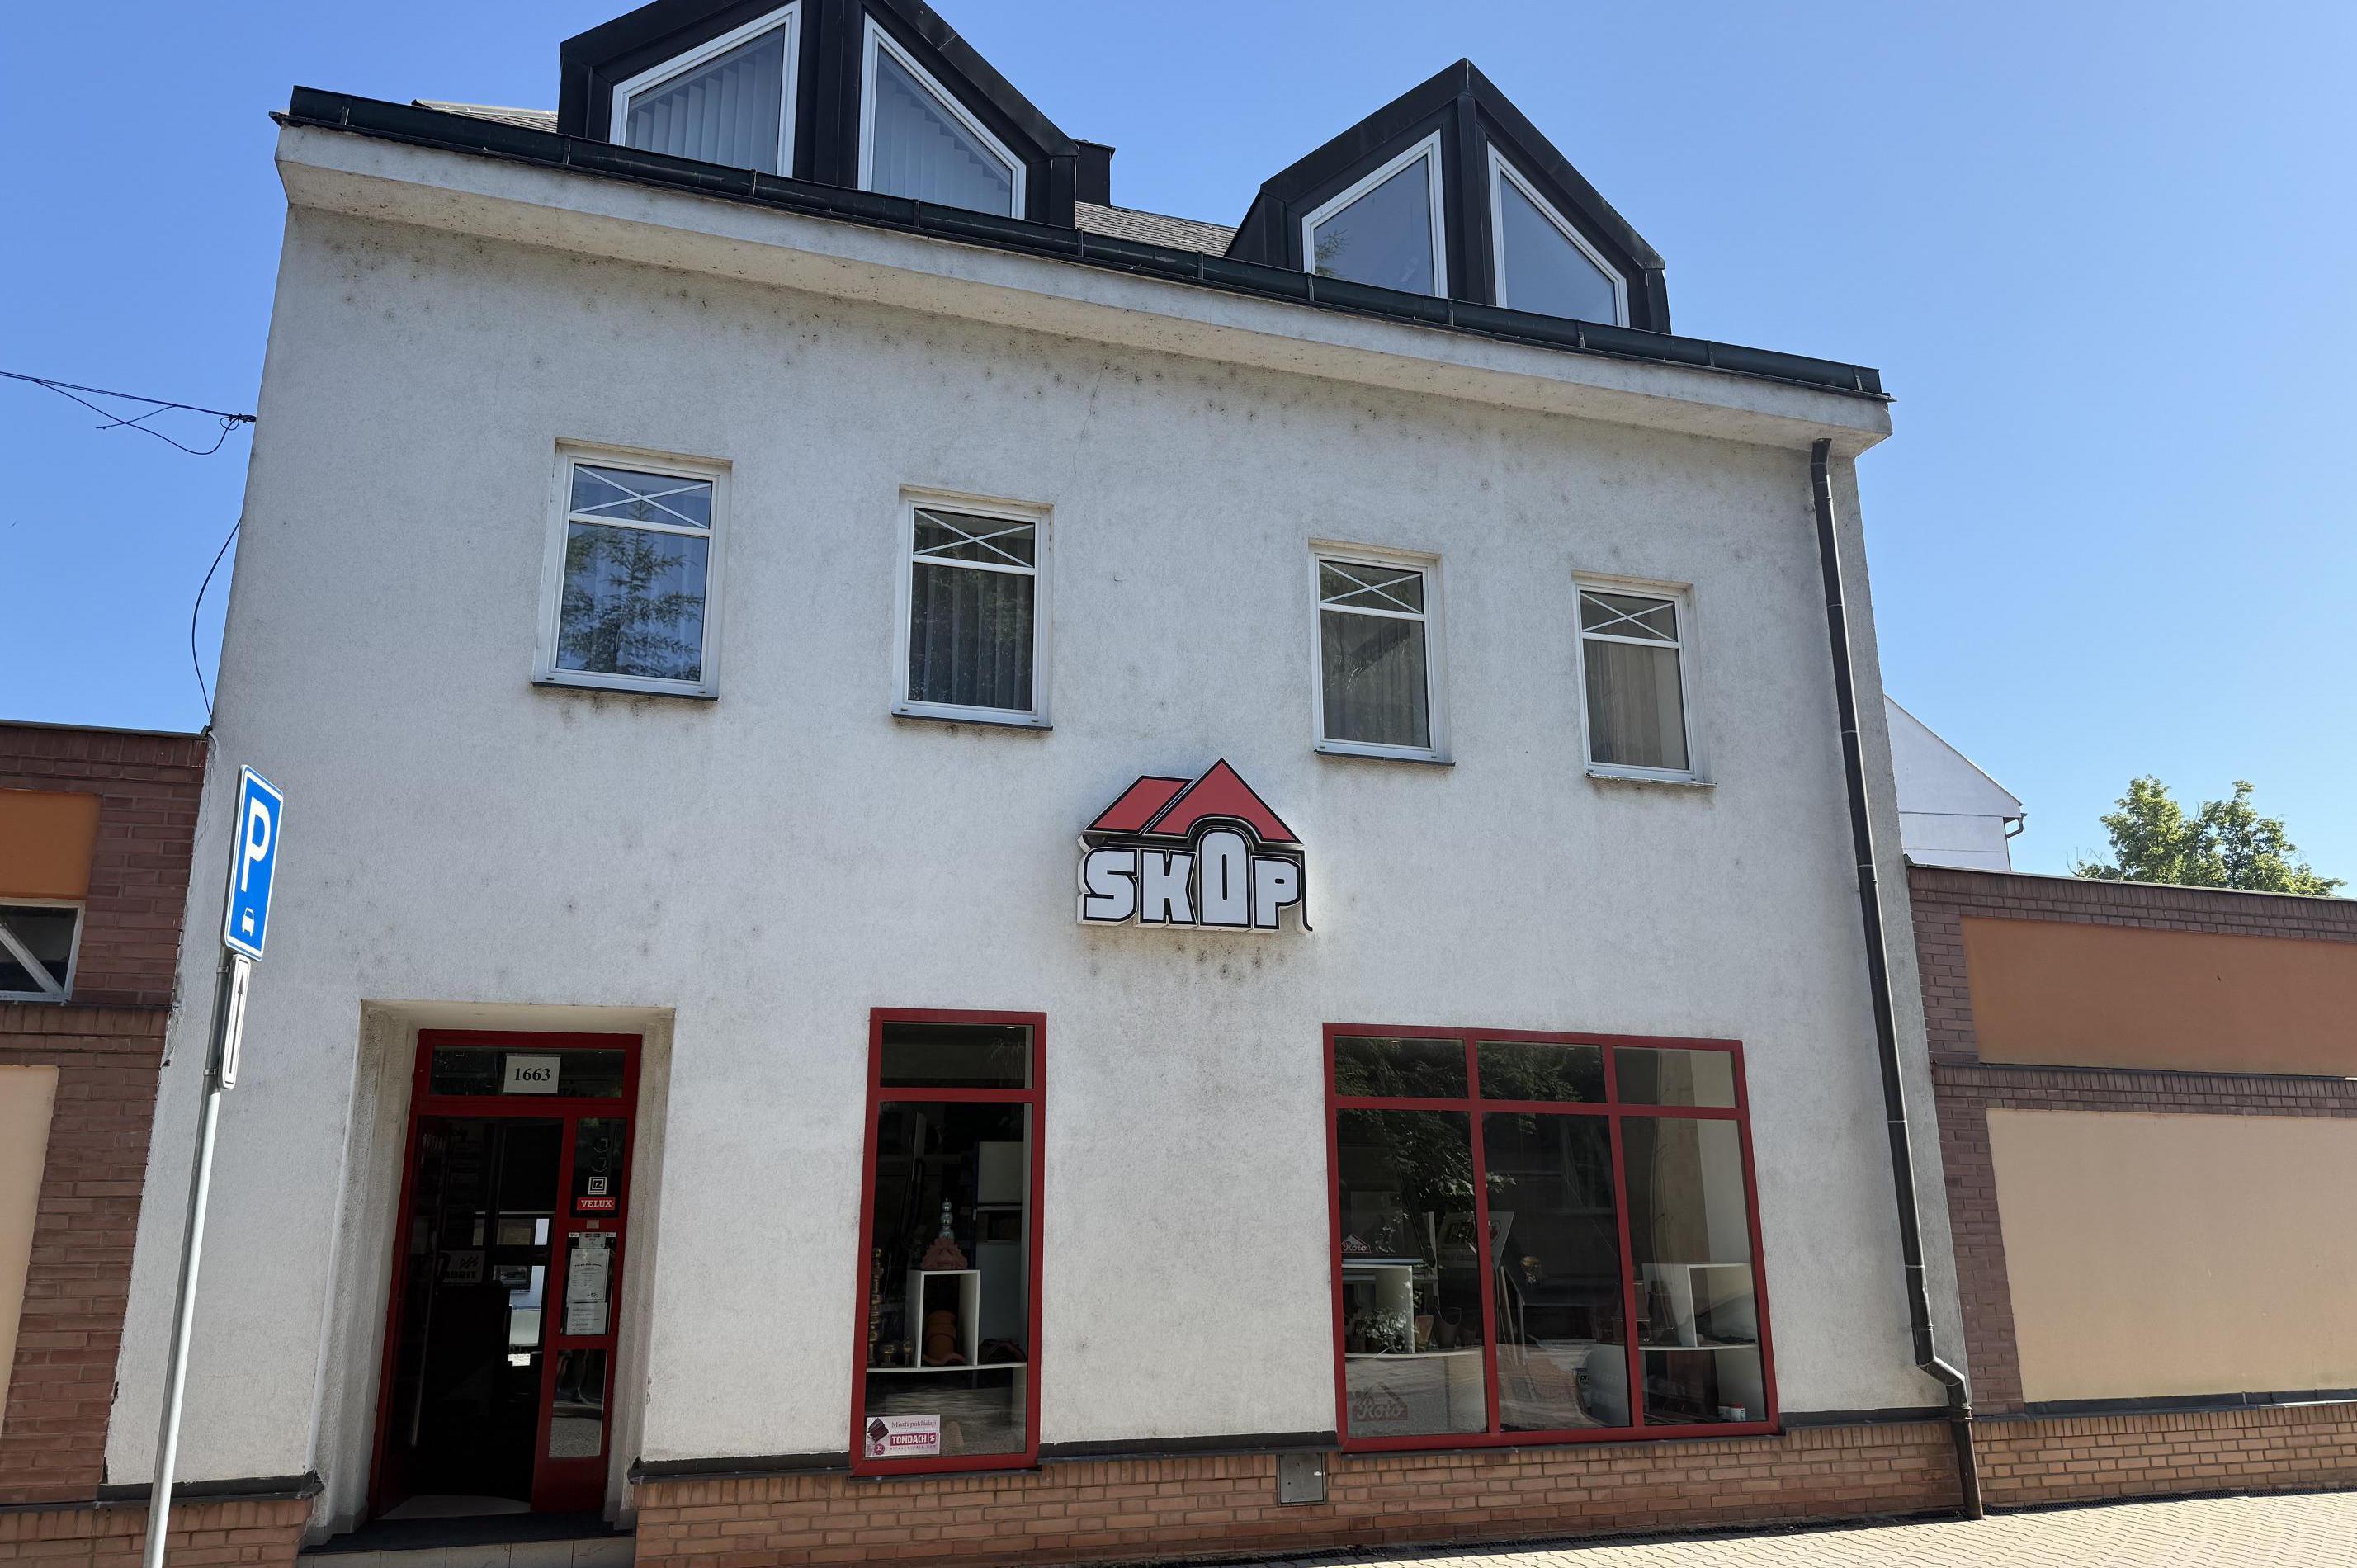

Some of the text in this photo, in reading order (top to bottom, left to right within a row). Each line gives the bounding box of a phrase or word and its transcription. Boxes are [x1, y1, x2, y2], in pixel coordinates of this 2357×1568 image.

[241, 796, 271, 893] P
[1082, 828, 1301, 930] SKOP
[513, 1067, 551, 1082] 1663
[581, 1199, 612, 1207] VELUX
[892, 1435, 926, 1444] TONDACH
